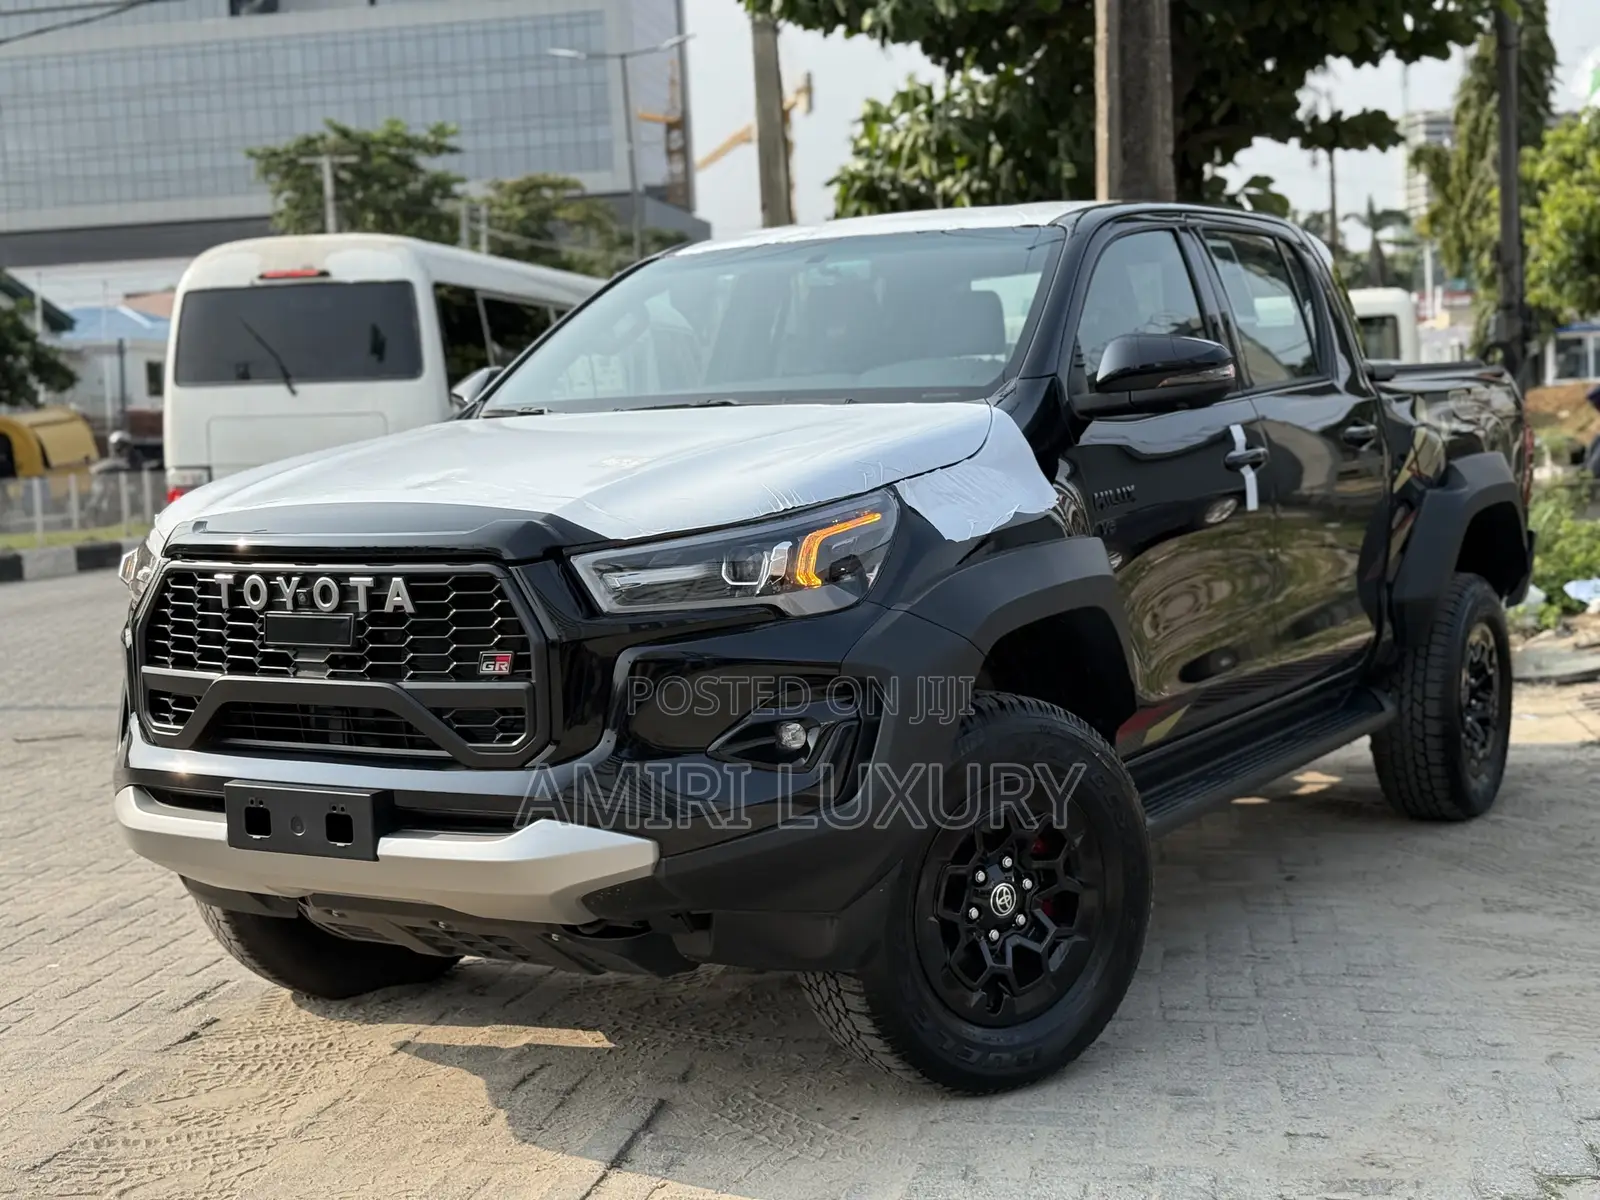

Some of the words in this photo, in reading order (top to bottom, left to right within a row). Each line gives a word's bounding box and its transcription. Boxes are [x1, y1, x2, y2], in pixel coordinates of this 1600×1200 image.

[1092, 485, 1137, 512] HILUX
[213, 573, 416, 614] TOYOTA
[482, 661, 509, 671] GR
